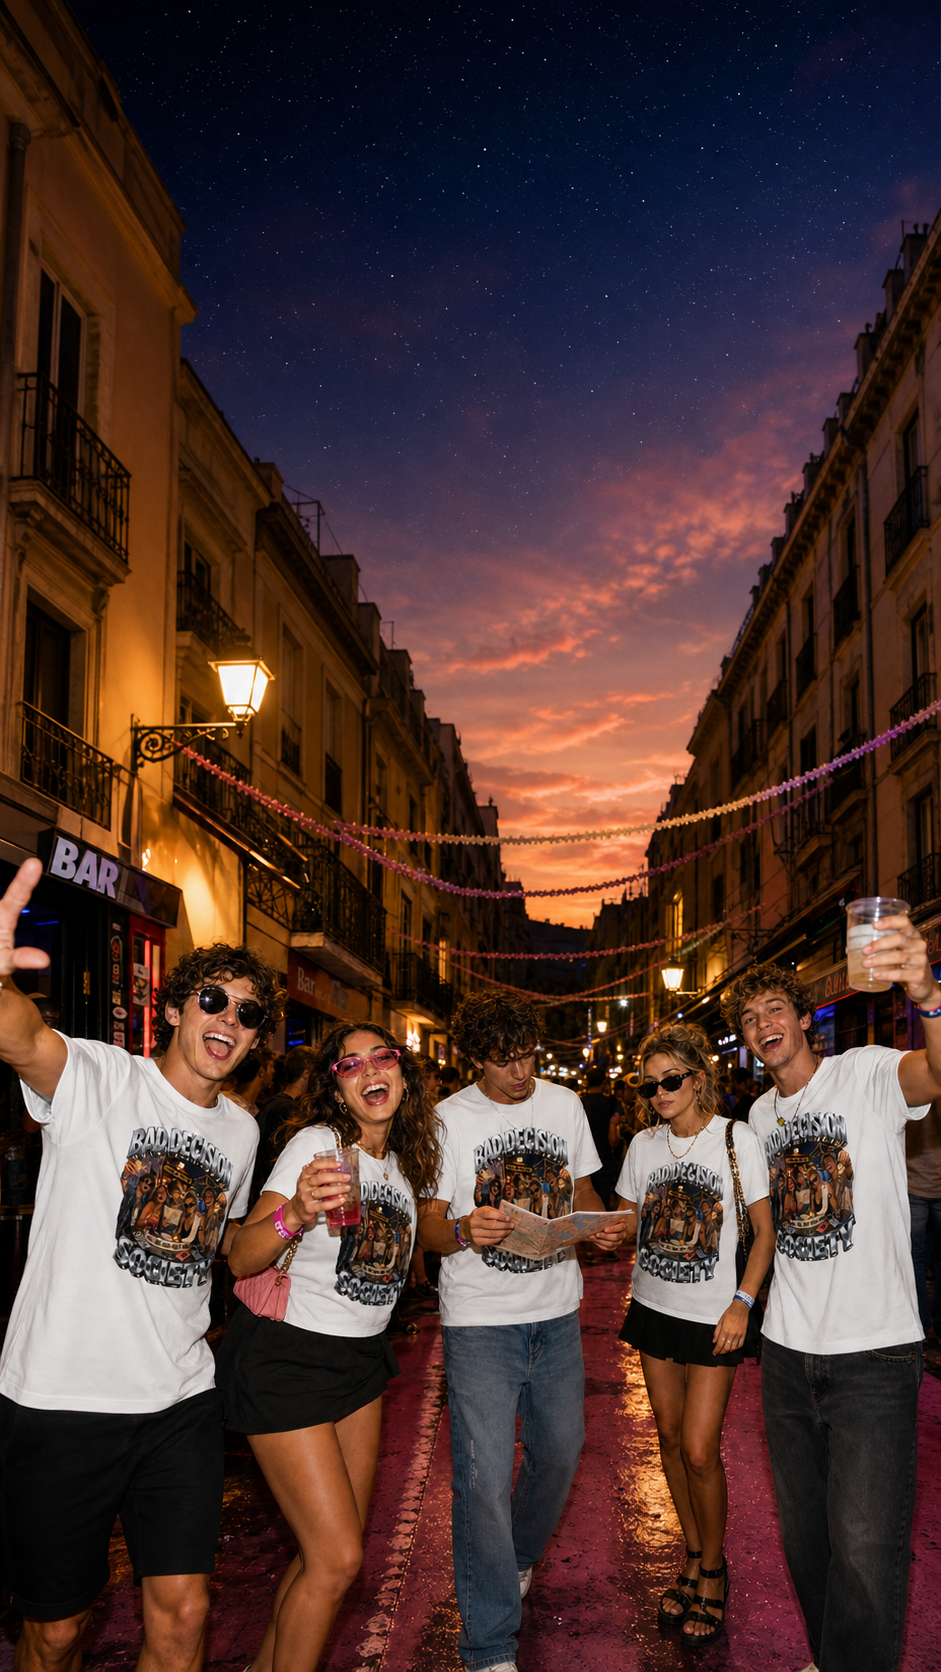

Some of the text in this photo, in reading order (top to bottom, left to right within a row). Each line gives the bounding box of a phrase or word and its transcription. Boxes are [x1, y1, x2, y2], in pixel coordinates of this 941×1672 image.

[50, 835, 118, 899] BAR
[297, 966, 315, 996] Bar
[473, 1126, 569, 1174] BAD DECISION
[781, 1111, 848, 1149] DECISION
[127, 1126, 168, 1159] BAD
[168, 1127, 233, 1191] DECISION
[645, 1161, 723, 1201] BAD DECISION
[113, 1235, 215, 1288] SOCIETY
[776, 1219, 855, 1262] SOCIETY
[638, 1247, 719, 1284] SOCIETY
